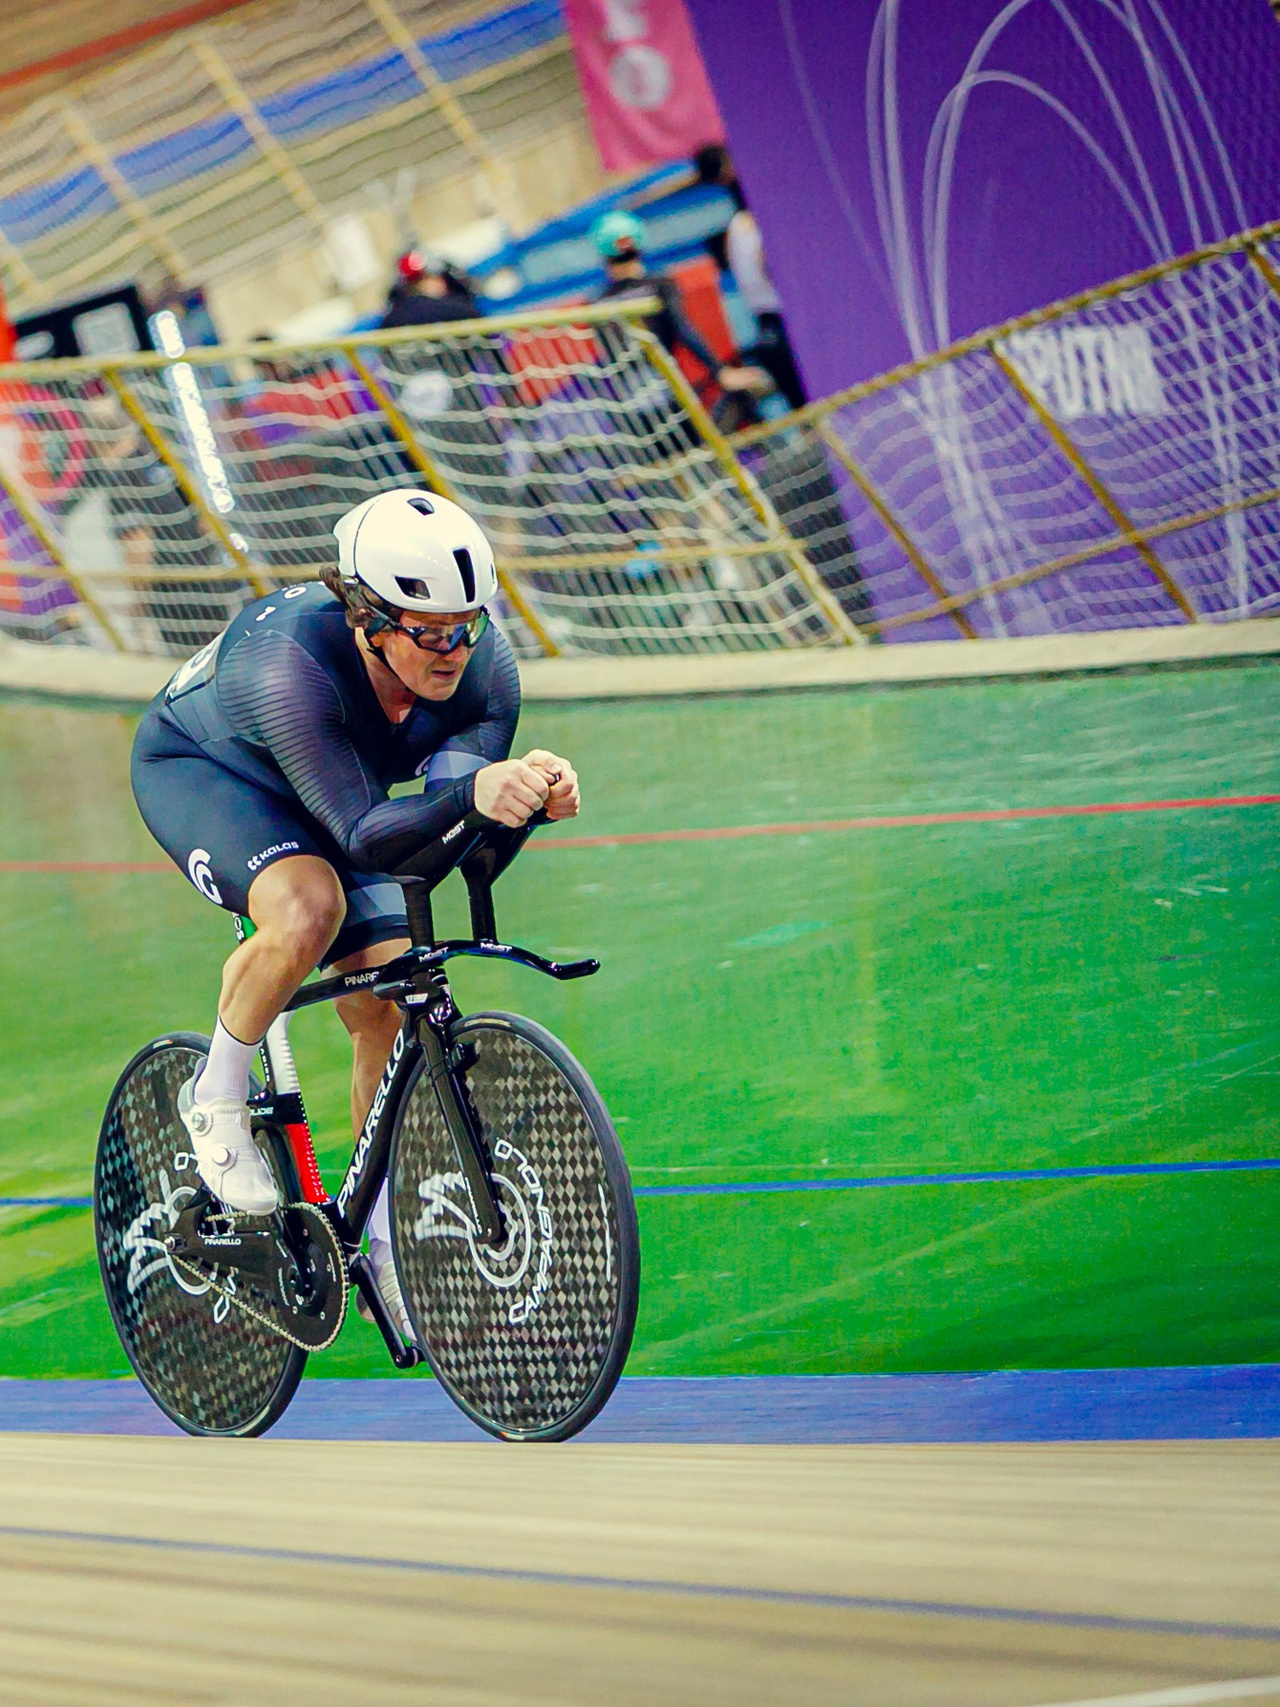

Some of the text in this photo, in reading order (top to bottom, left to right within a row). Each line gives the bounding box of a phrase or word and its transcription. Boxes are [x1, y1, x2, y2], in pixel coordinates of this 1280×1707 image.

[441, 820, 465, 845] MOST
[418, 946, 449, 963] MOST
[480, 942, 513, 953] MOST
[337, 1028, 404, 1219] PINARELLO
[204, 1238, 242, 1246] PINARELLO
[494, 1138, 554, 1325] CAMPAGNOLO
